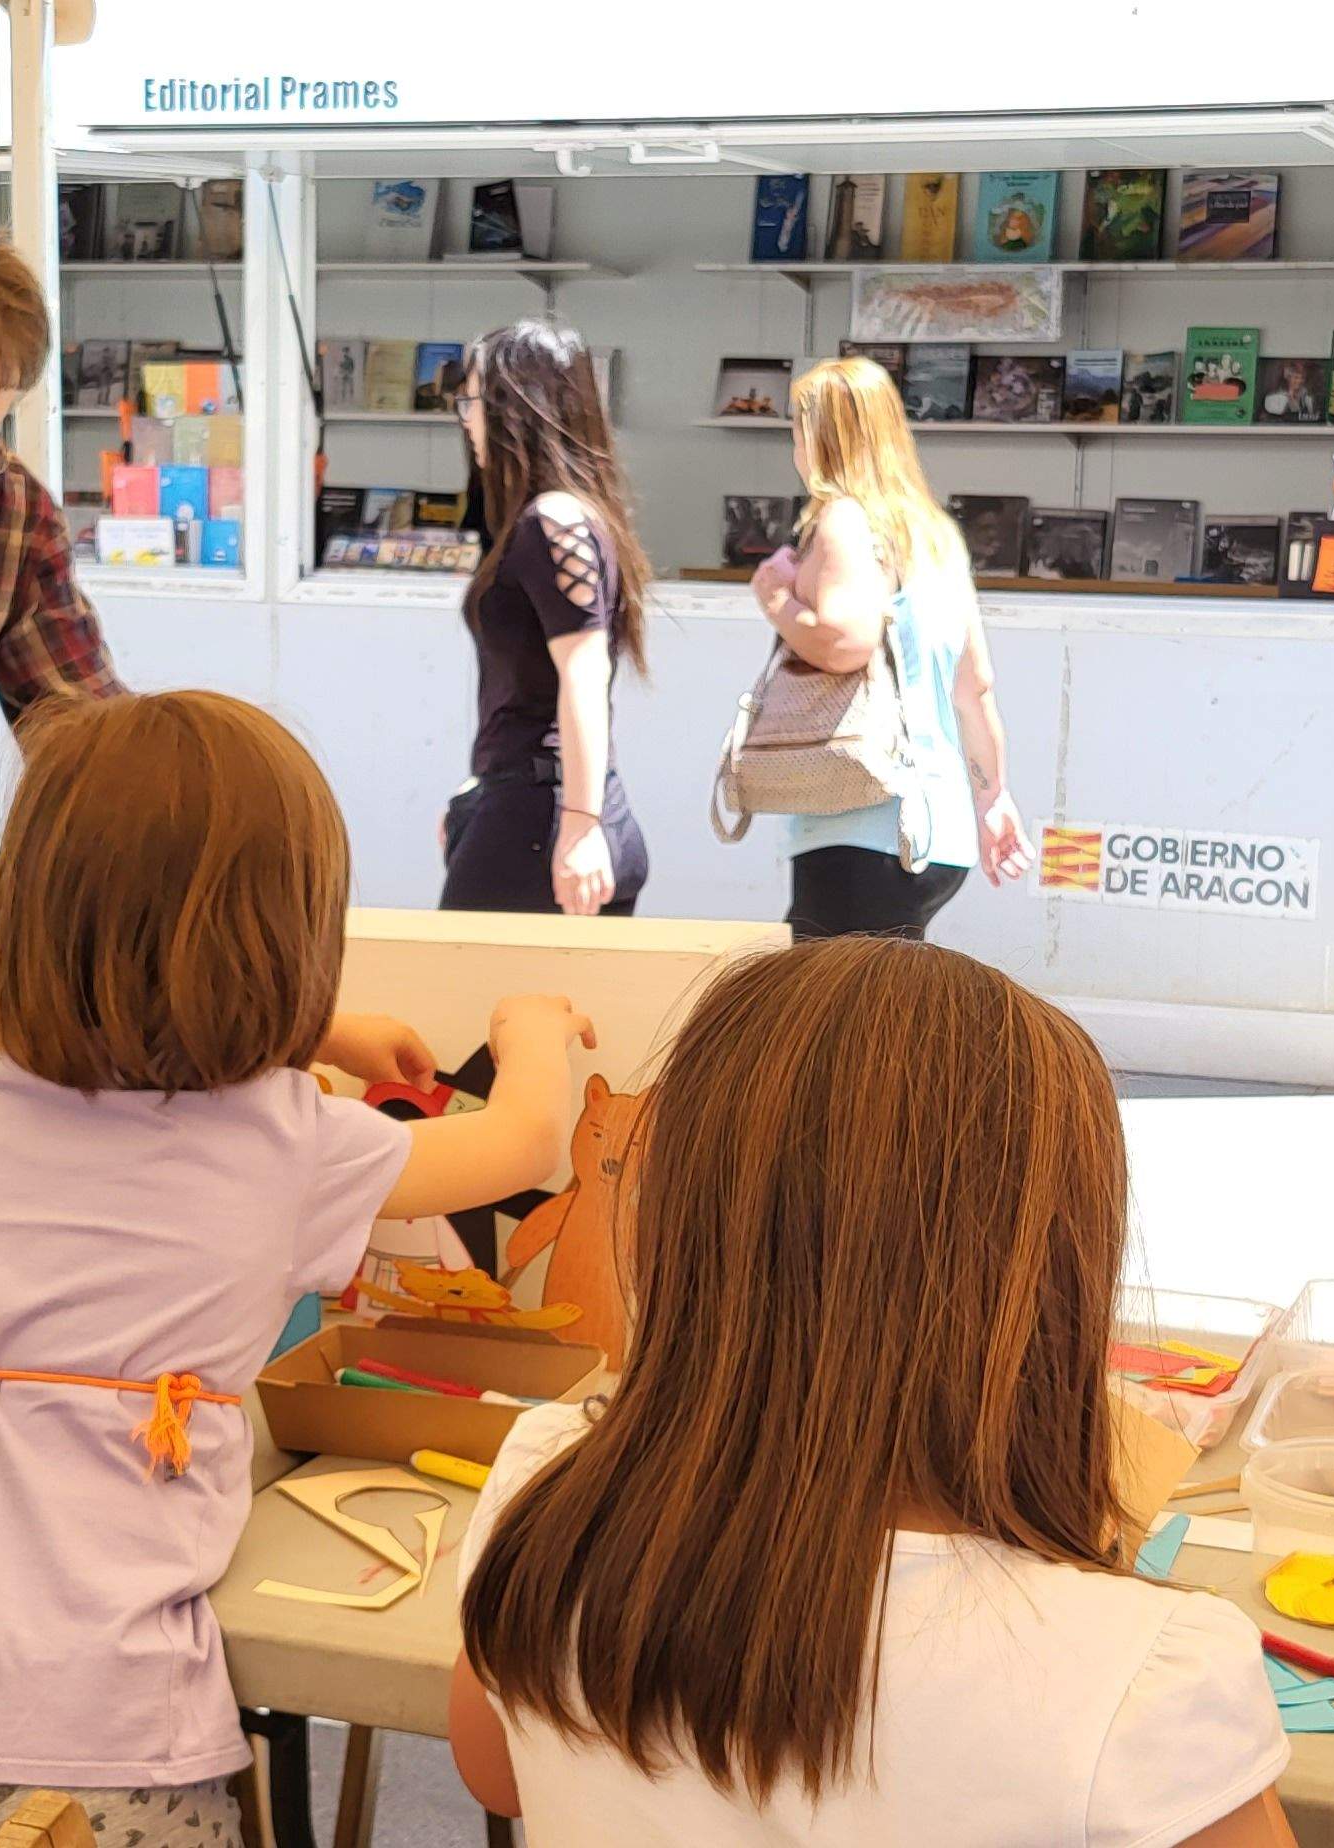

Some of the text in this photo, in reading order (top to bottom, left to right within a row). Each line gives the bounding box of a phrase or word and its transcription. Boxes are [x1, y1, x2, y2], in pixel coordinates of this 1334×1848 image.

[144, 76, 398, 112] Editorial Prames
[1107, 833, 1285, 872] GOBIERNO
[1104, 866, 1310, 909] DE ARAGON
